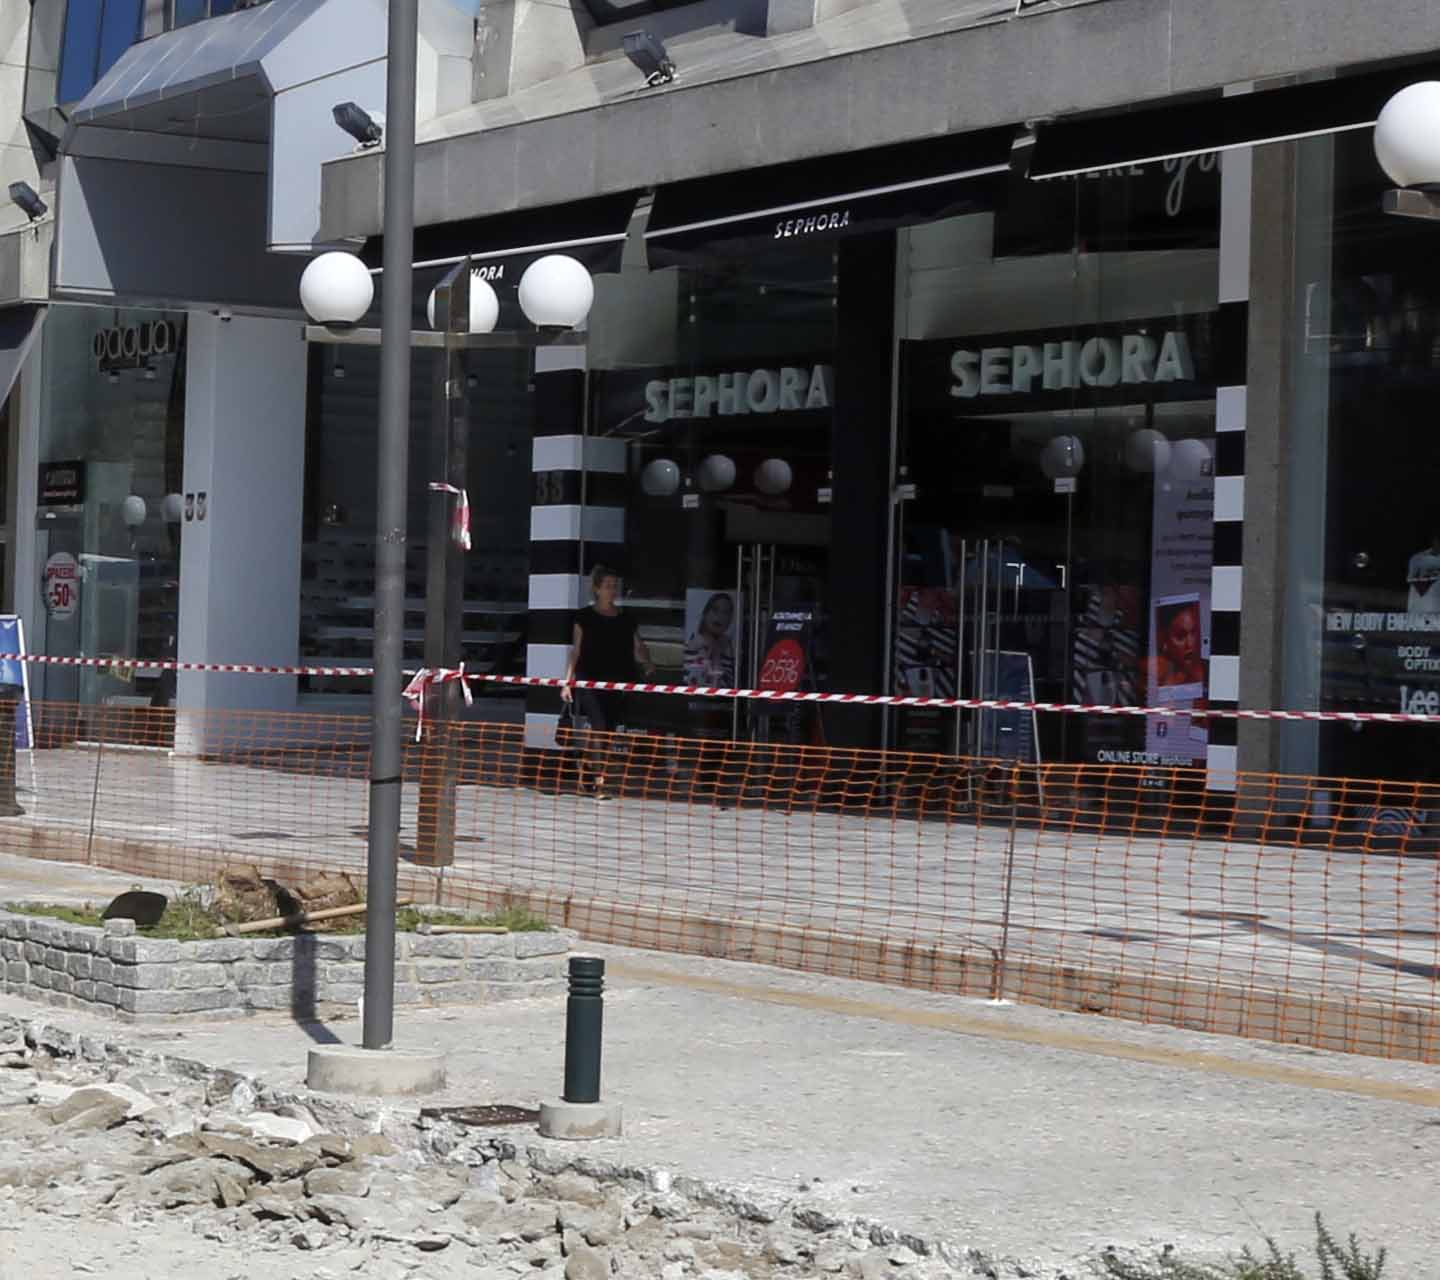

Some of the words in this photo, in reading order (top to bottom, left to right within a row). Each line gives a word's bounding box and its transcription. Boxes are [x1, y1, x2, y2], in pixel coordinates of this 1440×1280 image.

[774, 209, 850, 240] SEPHORA
[951, 331, 1196, 399] SEPHORA
[644, 364, 832, 422] SEPHORA
[1326, 613, 1352, 632] NEW
[1353, 613, 1384, 631] BODY
[1397, 646, 1430, 659] BODY
[759, 658, 800, 684] 25%
[1400, 685, 1440, 715] Lee
[1097, 749, 1133, 763] ONLINE
[1132, 751, 1161, 765] STORE
